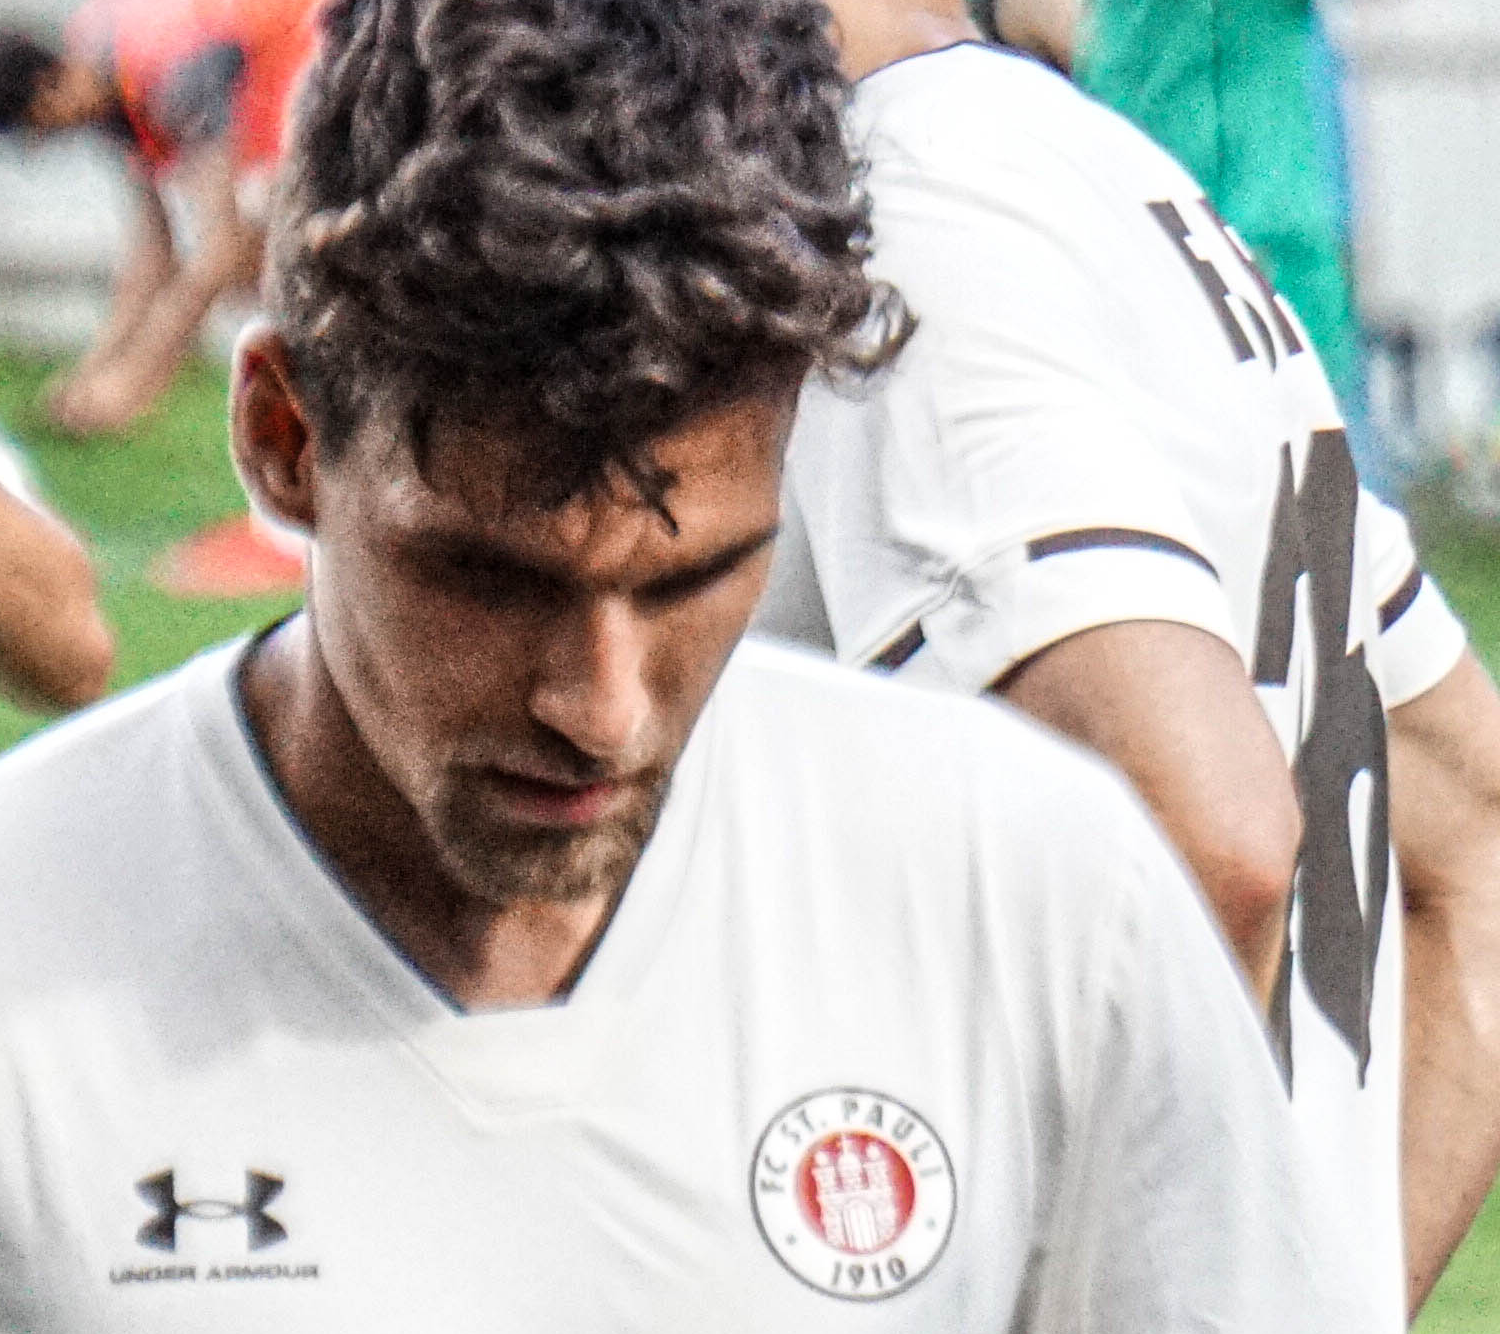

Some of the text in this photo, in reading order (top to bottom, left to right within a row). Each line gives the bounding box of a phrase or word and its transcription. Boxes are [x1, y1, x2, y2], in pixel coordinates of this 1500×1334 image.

[759, 1154, 788, 1194] FC
[842, 1097, 943, 1178] PAULI
[108, 1263, 320, 1286] UNDER ARMOUR
[831, 1256, 908, 1289] 1910
